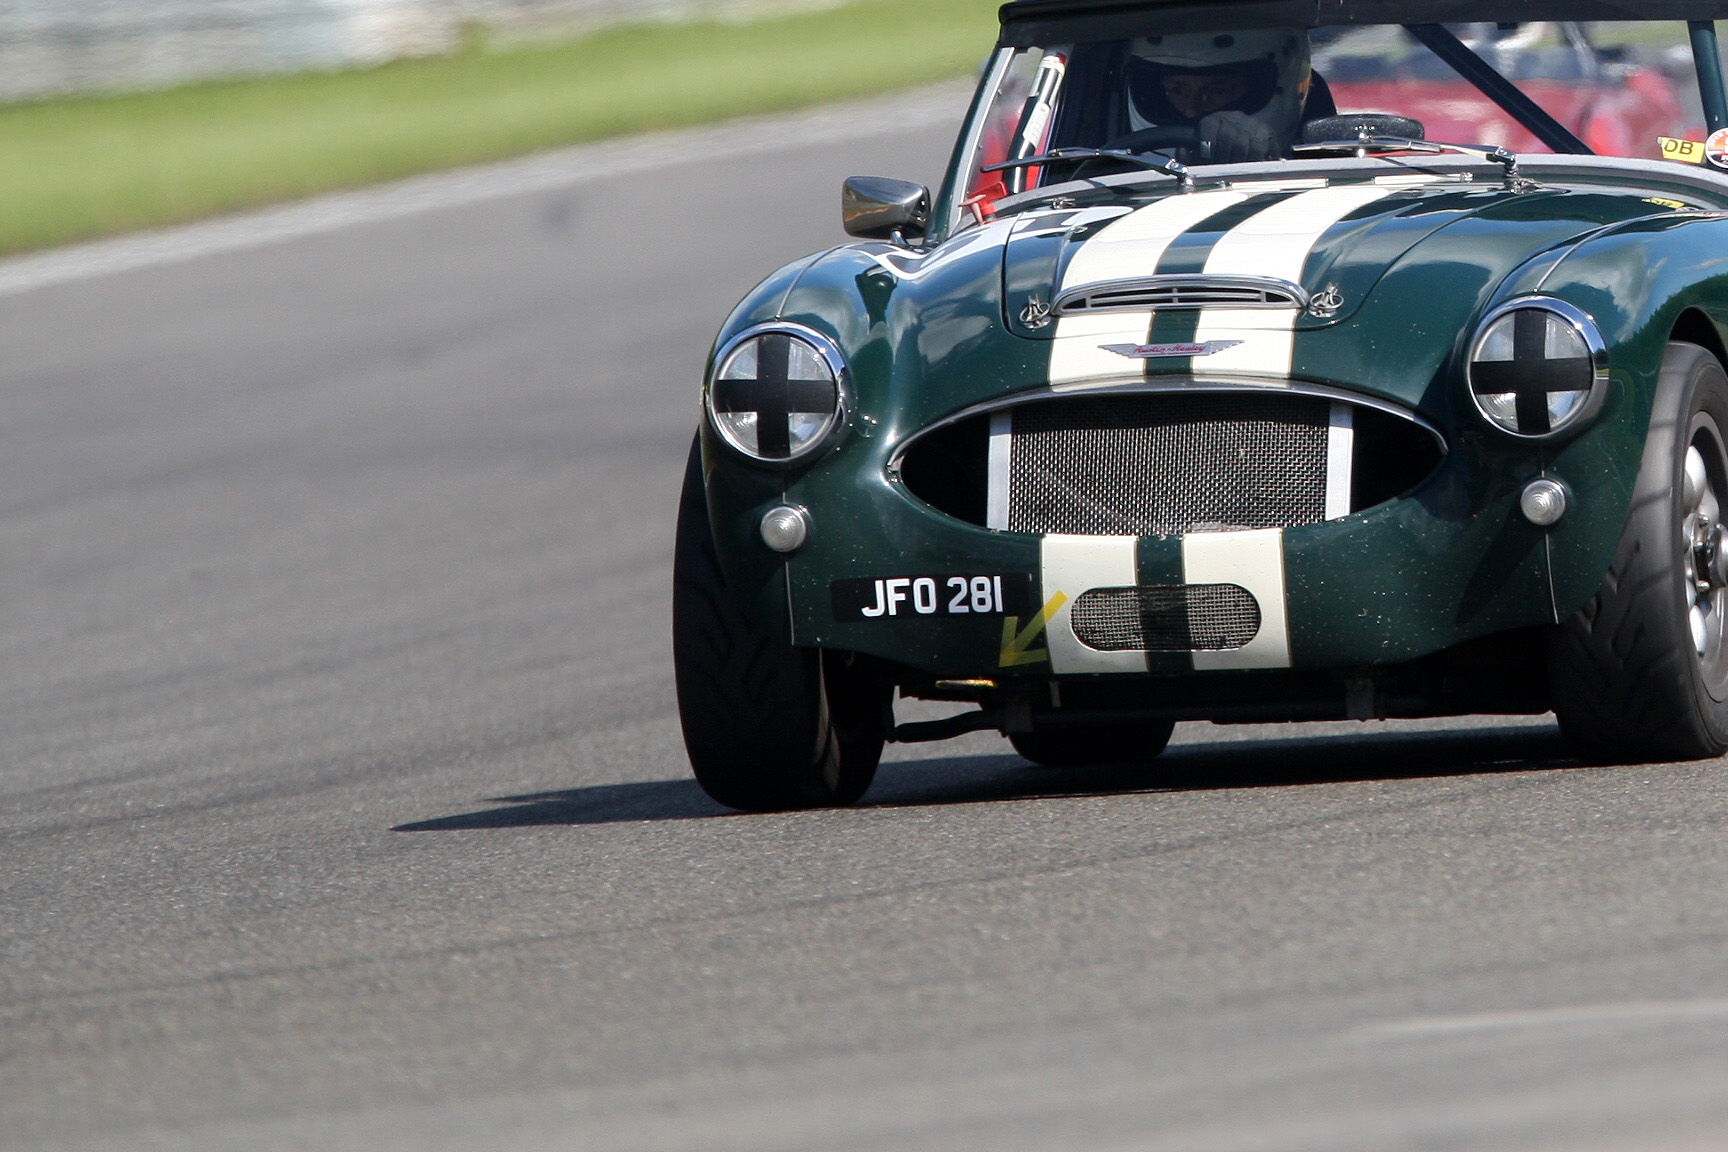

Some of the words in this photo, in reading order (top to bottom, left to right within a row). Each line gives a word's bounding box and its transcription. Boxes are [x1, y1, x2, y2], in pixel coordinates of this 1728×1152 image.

[1664, 139, 1694, 155] DB
[861, 577, 936, 617] JFO
[947, 575, 1003, 614] 281
